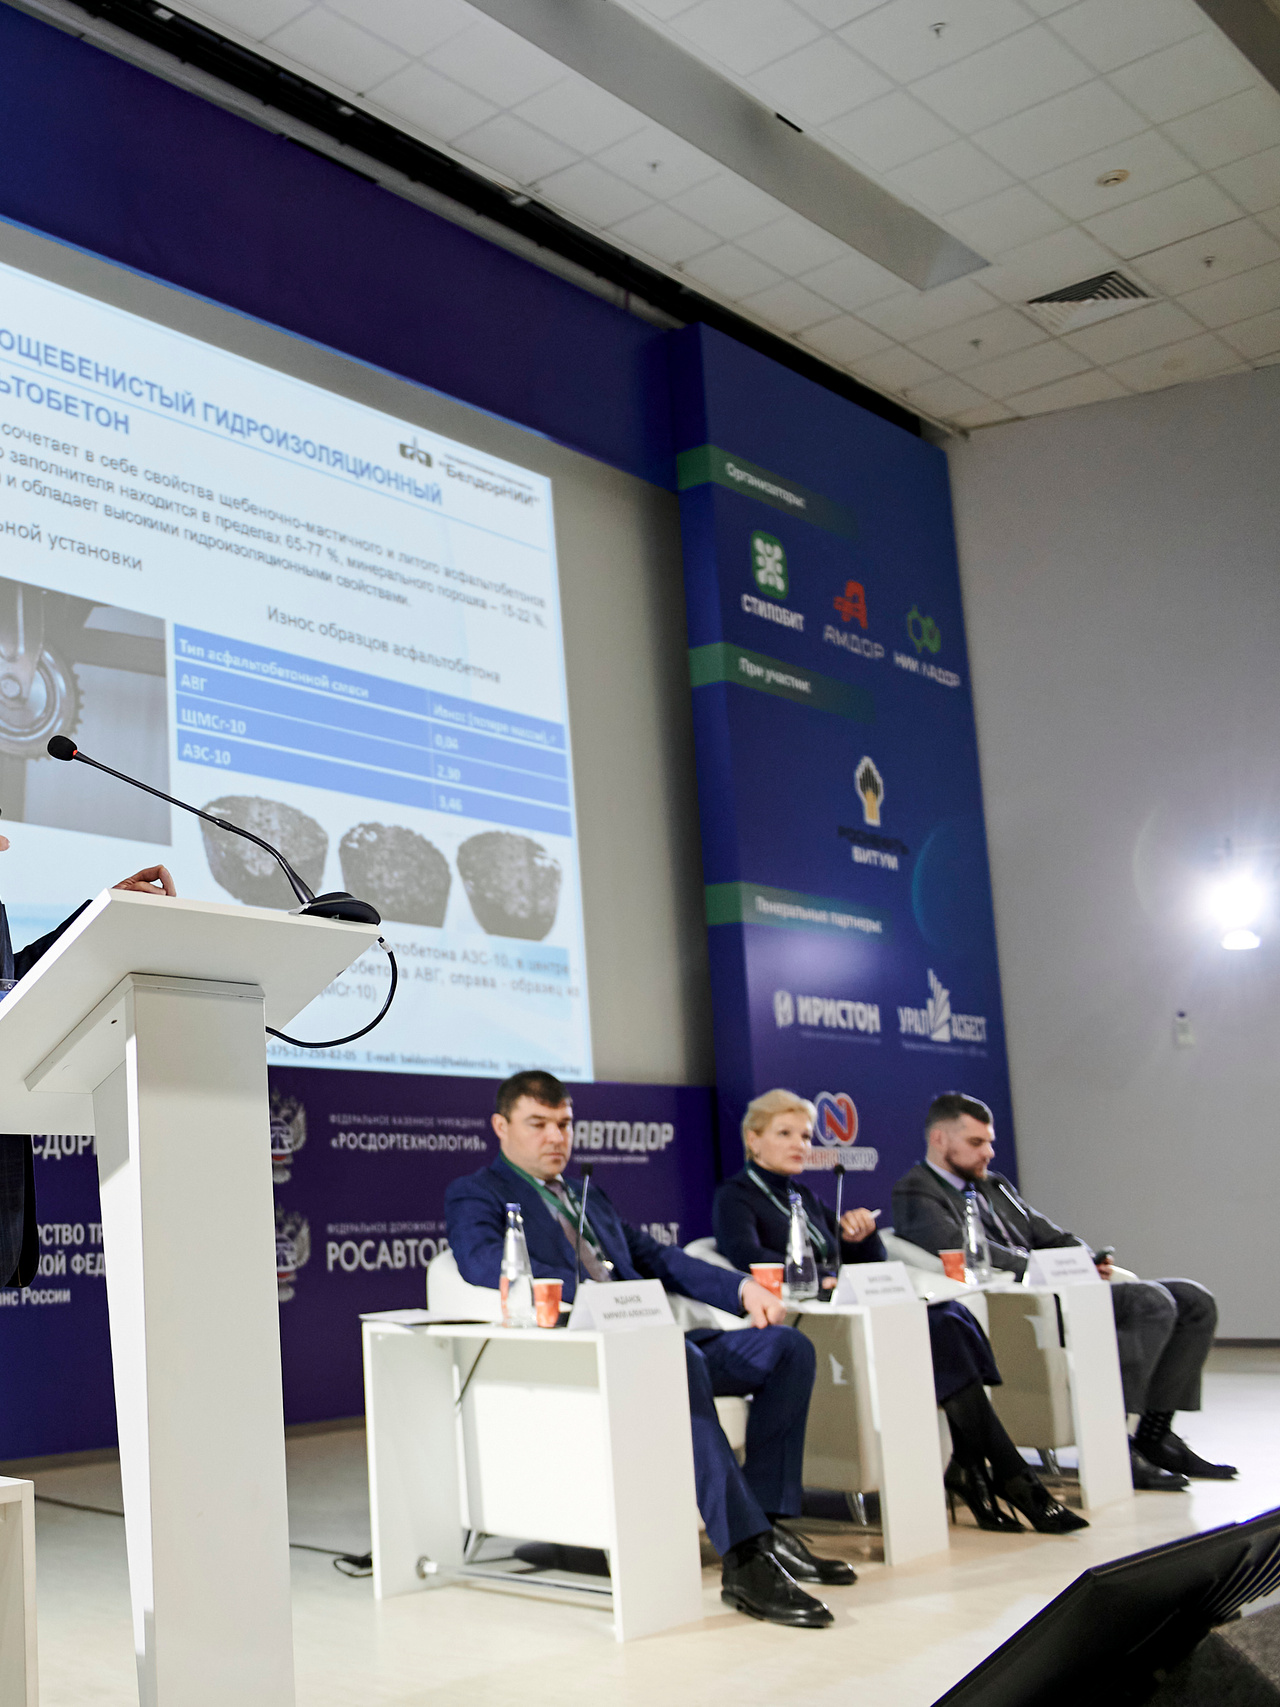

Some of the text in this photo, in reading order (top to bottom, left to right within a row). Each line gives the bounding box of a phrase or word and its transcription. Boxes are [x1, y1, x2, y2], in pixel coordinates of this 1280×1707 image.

[1, 422, 80, 458] сочетает
[85, 450, 95, 463] в
[100, 453, 139, 477] себе
[143, 468, 215, 502] свойства
[202, 401, 443, 506] ГИДРОИЗОЛЯЦИОННЫЙ
[6, 473, 17, 488] и
[21, 478, 99, 513] обладает
[104, 504, 181, 538] высокими
[183, 527, 333, 582] гидроизоляционными
[9, 451, 115, 493] заполнителя
[119, 485, 198, 520] находится
[202, 510, 211, 524] в
[215, 515, 282, 545] пределах
[47, 531, 144, 572] установки
[179, 638, 206, 660] Тип
[207, 648, 331, 690] асфальтобетонной
[267, 605, 501, 685] Износ образцов асфальтобетона
[179, 672, 209, 692] АВГ
[330, 1131, 488, 1152] «РОСДОРТЕХНОЛОГИЯ»
[21, 1286, 71, 1306] России
